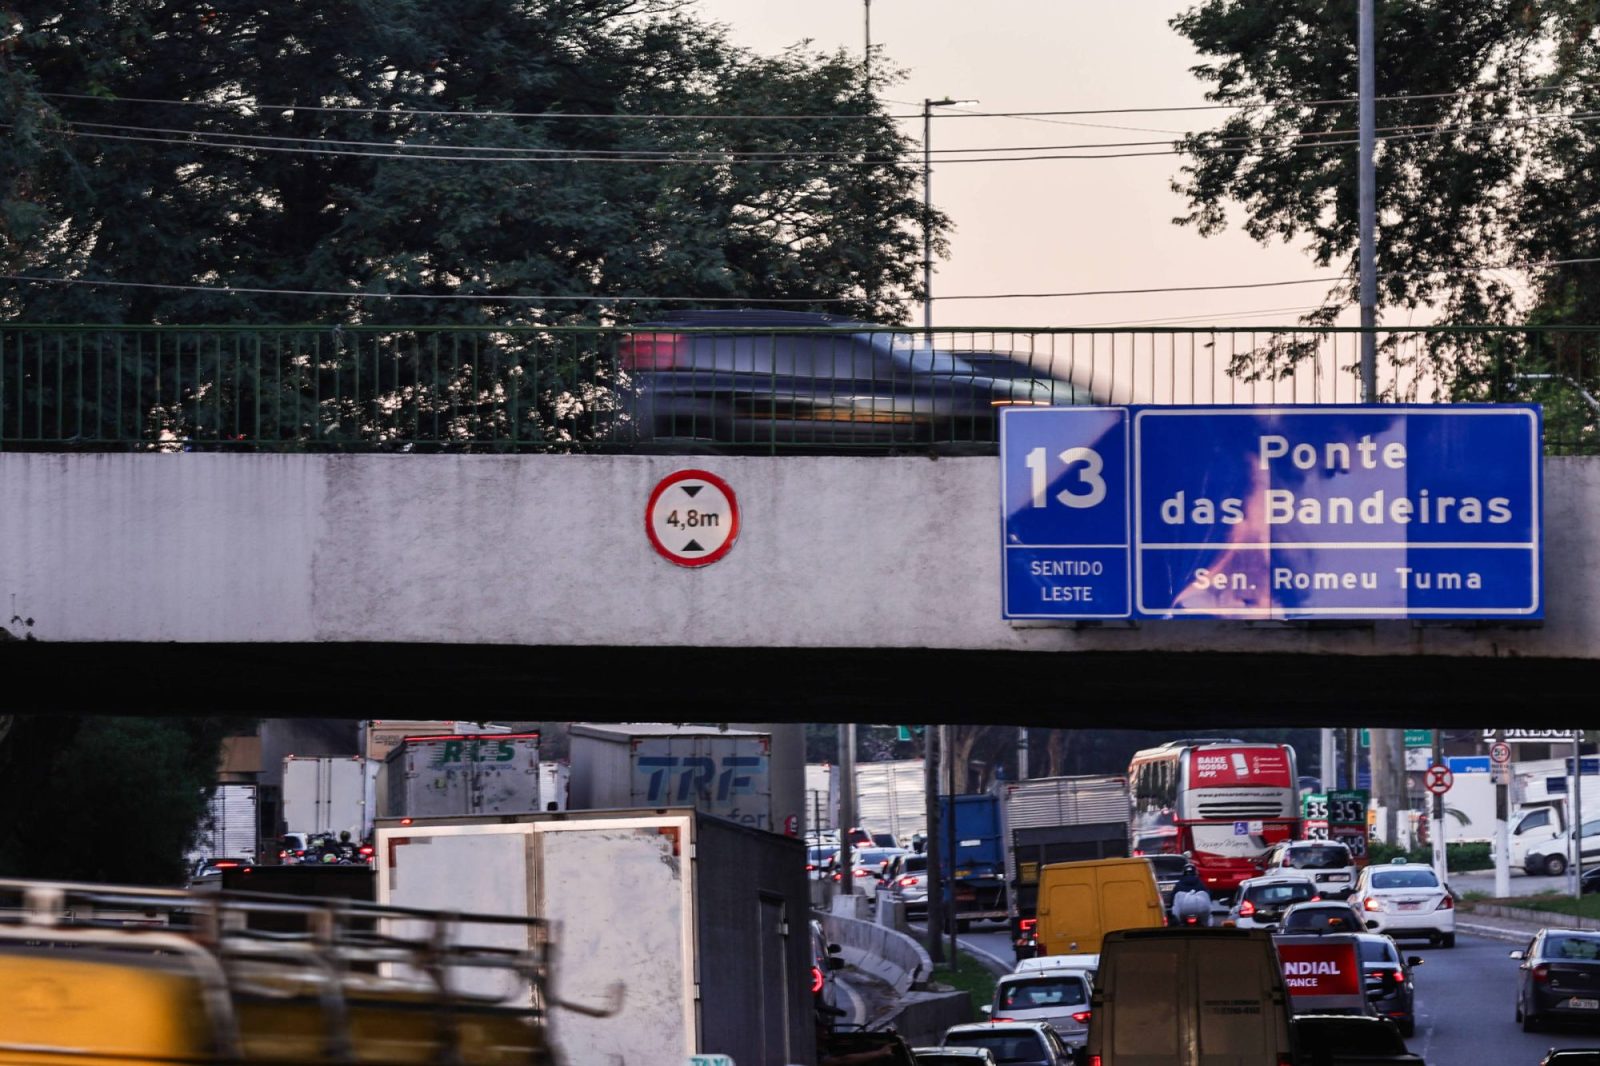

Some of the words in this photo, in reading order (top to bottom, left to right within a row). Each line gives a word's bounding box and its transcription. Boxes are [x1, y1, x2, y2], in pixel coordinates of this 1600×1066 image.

[1259, 435, 1407, 470] Ponte
[1025, 447, 1107, 508] 13
[1161, 491, 1244, 524] das
[1264, 489, 1512, 524] Bandeiras
[667, 509, 719, 530] 4,8m
[1031, 561, 1103, 575] SENTIDO
[1193, 567, 1256, 589] Sen.
[1274, 567, 1378, 589] Romeu
[1396, 567, 1482, 589] Tuma
[1042, 586, 1093, 601] LESTE
[1197, 756, 1227, 764] BAIXE
[1198, 763, 1228, 771] NOSSO
[637, 756, 763, 804] TRF
